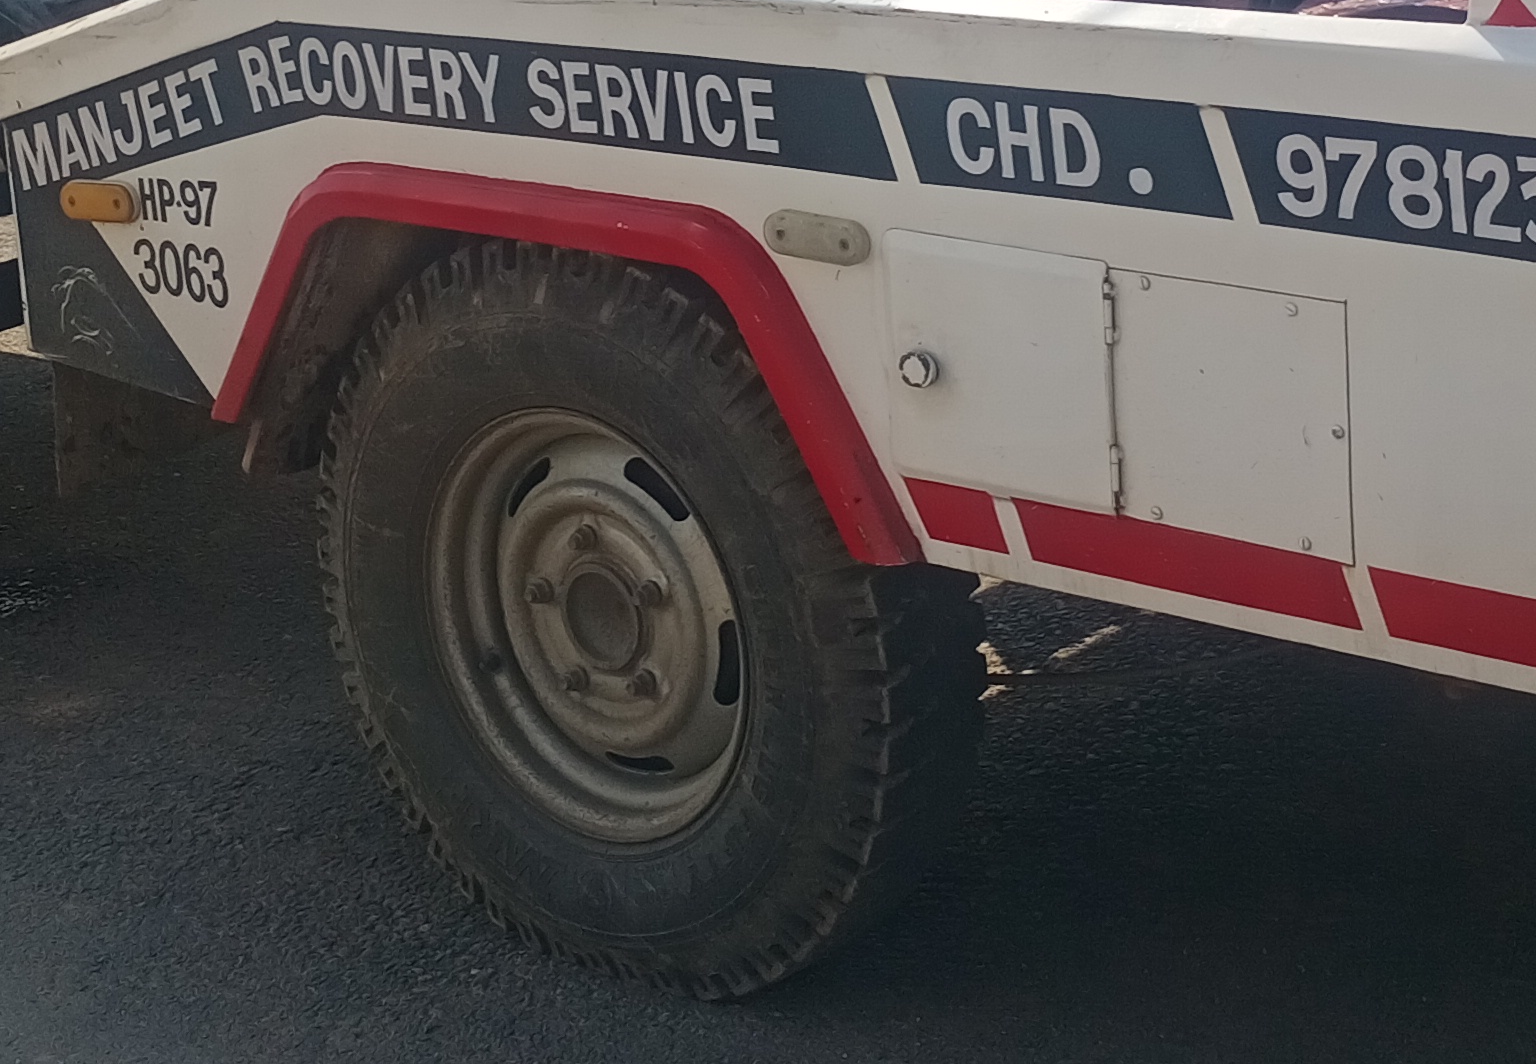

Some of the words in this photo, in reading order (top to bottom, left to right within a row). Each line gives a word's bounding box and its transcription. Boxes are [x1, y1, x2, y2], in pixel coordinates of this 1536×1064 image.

[13, 59, 224, 191] MANJEET
[239, 36, 500, 123] RECOVERY
[528, 58, 780, 153] SERVICE
[133, 238, 229, 308] 3063
